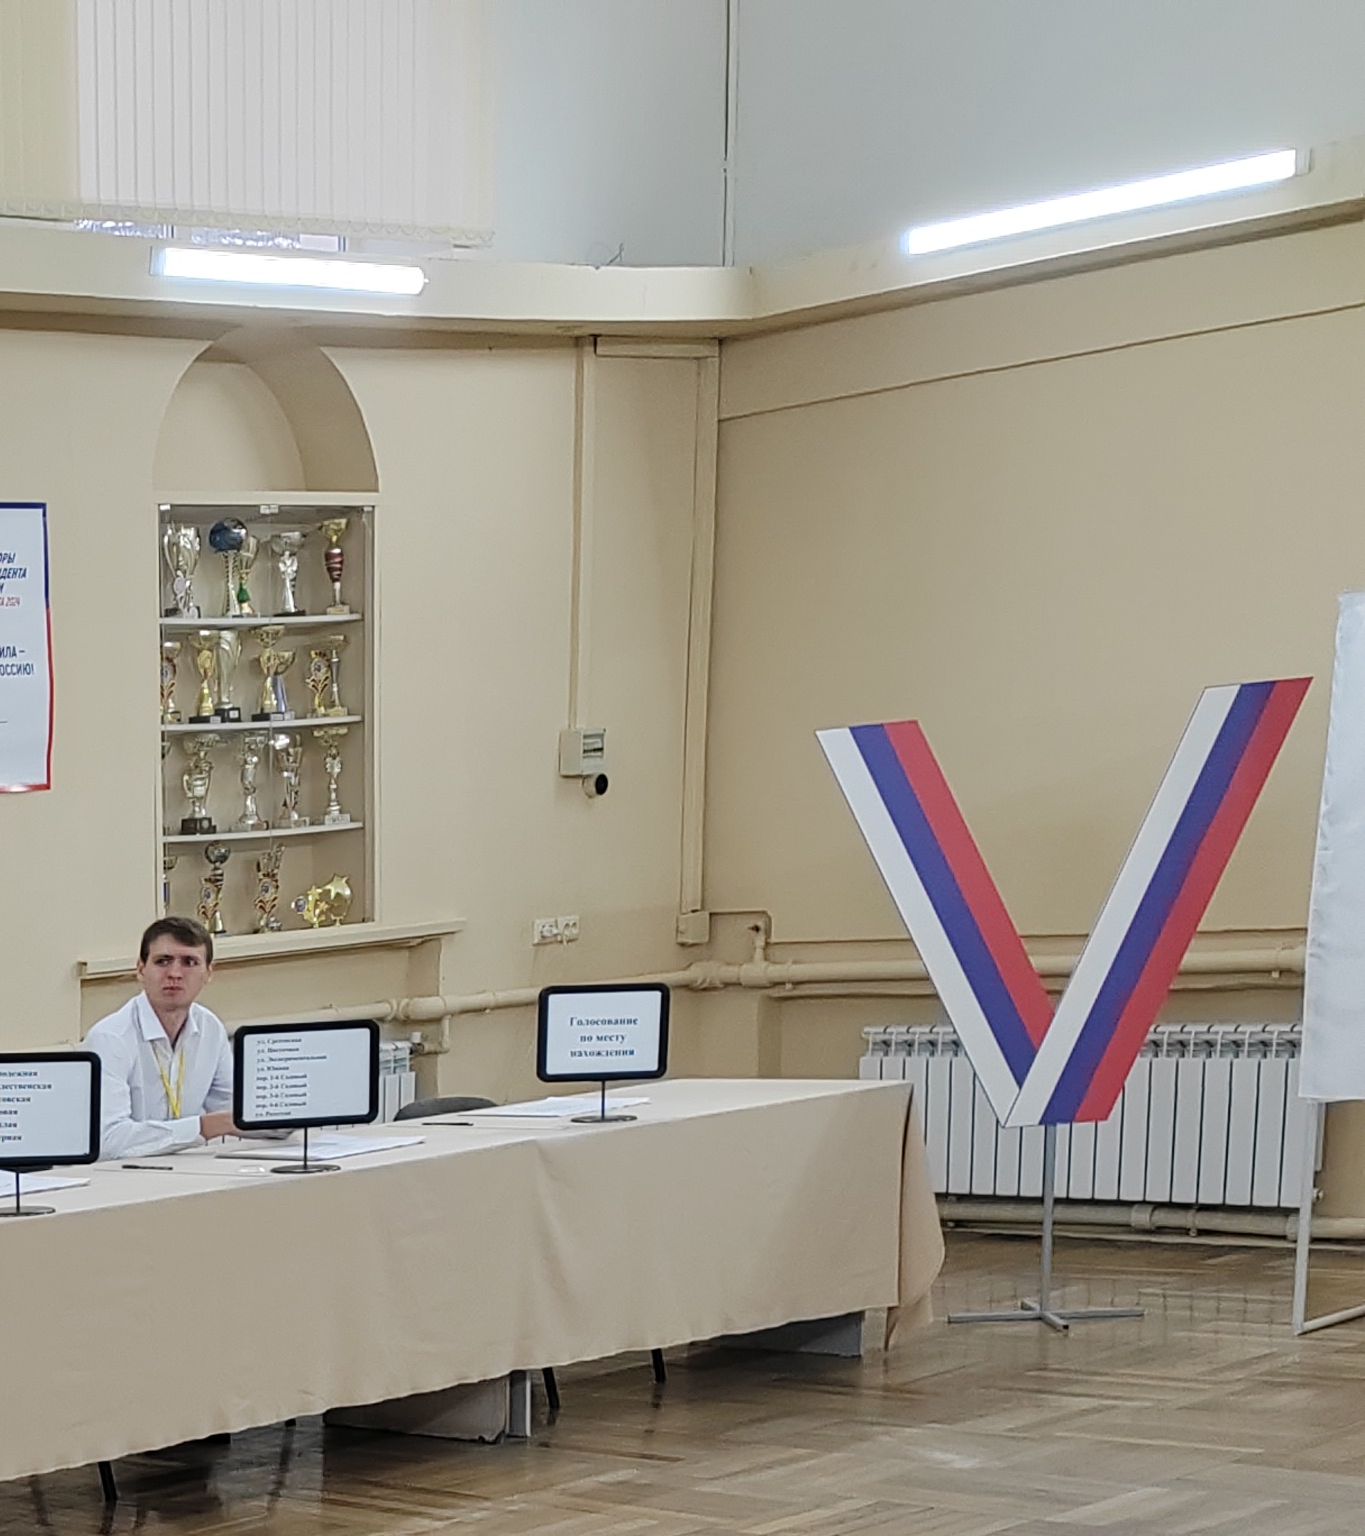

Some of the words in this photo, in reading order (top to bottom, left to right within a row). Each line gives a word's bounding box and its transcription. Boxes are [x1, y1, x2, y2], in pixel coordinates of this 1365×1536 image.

[570, 1016, 638, 1026] Голосование
[596, 1034, 626, 1044] месту
[570, 1049, 635, 1058] нахождения
